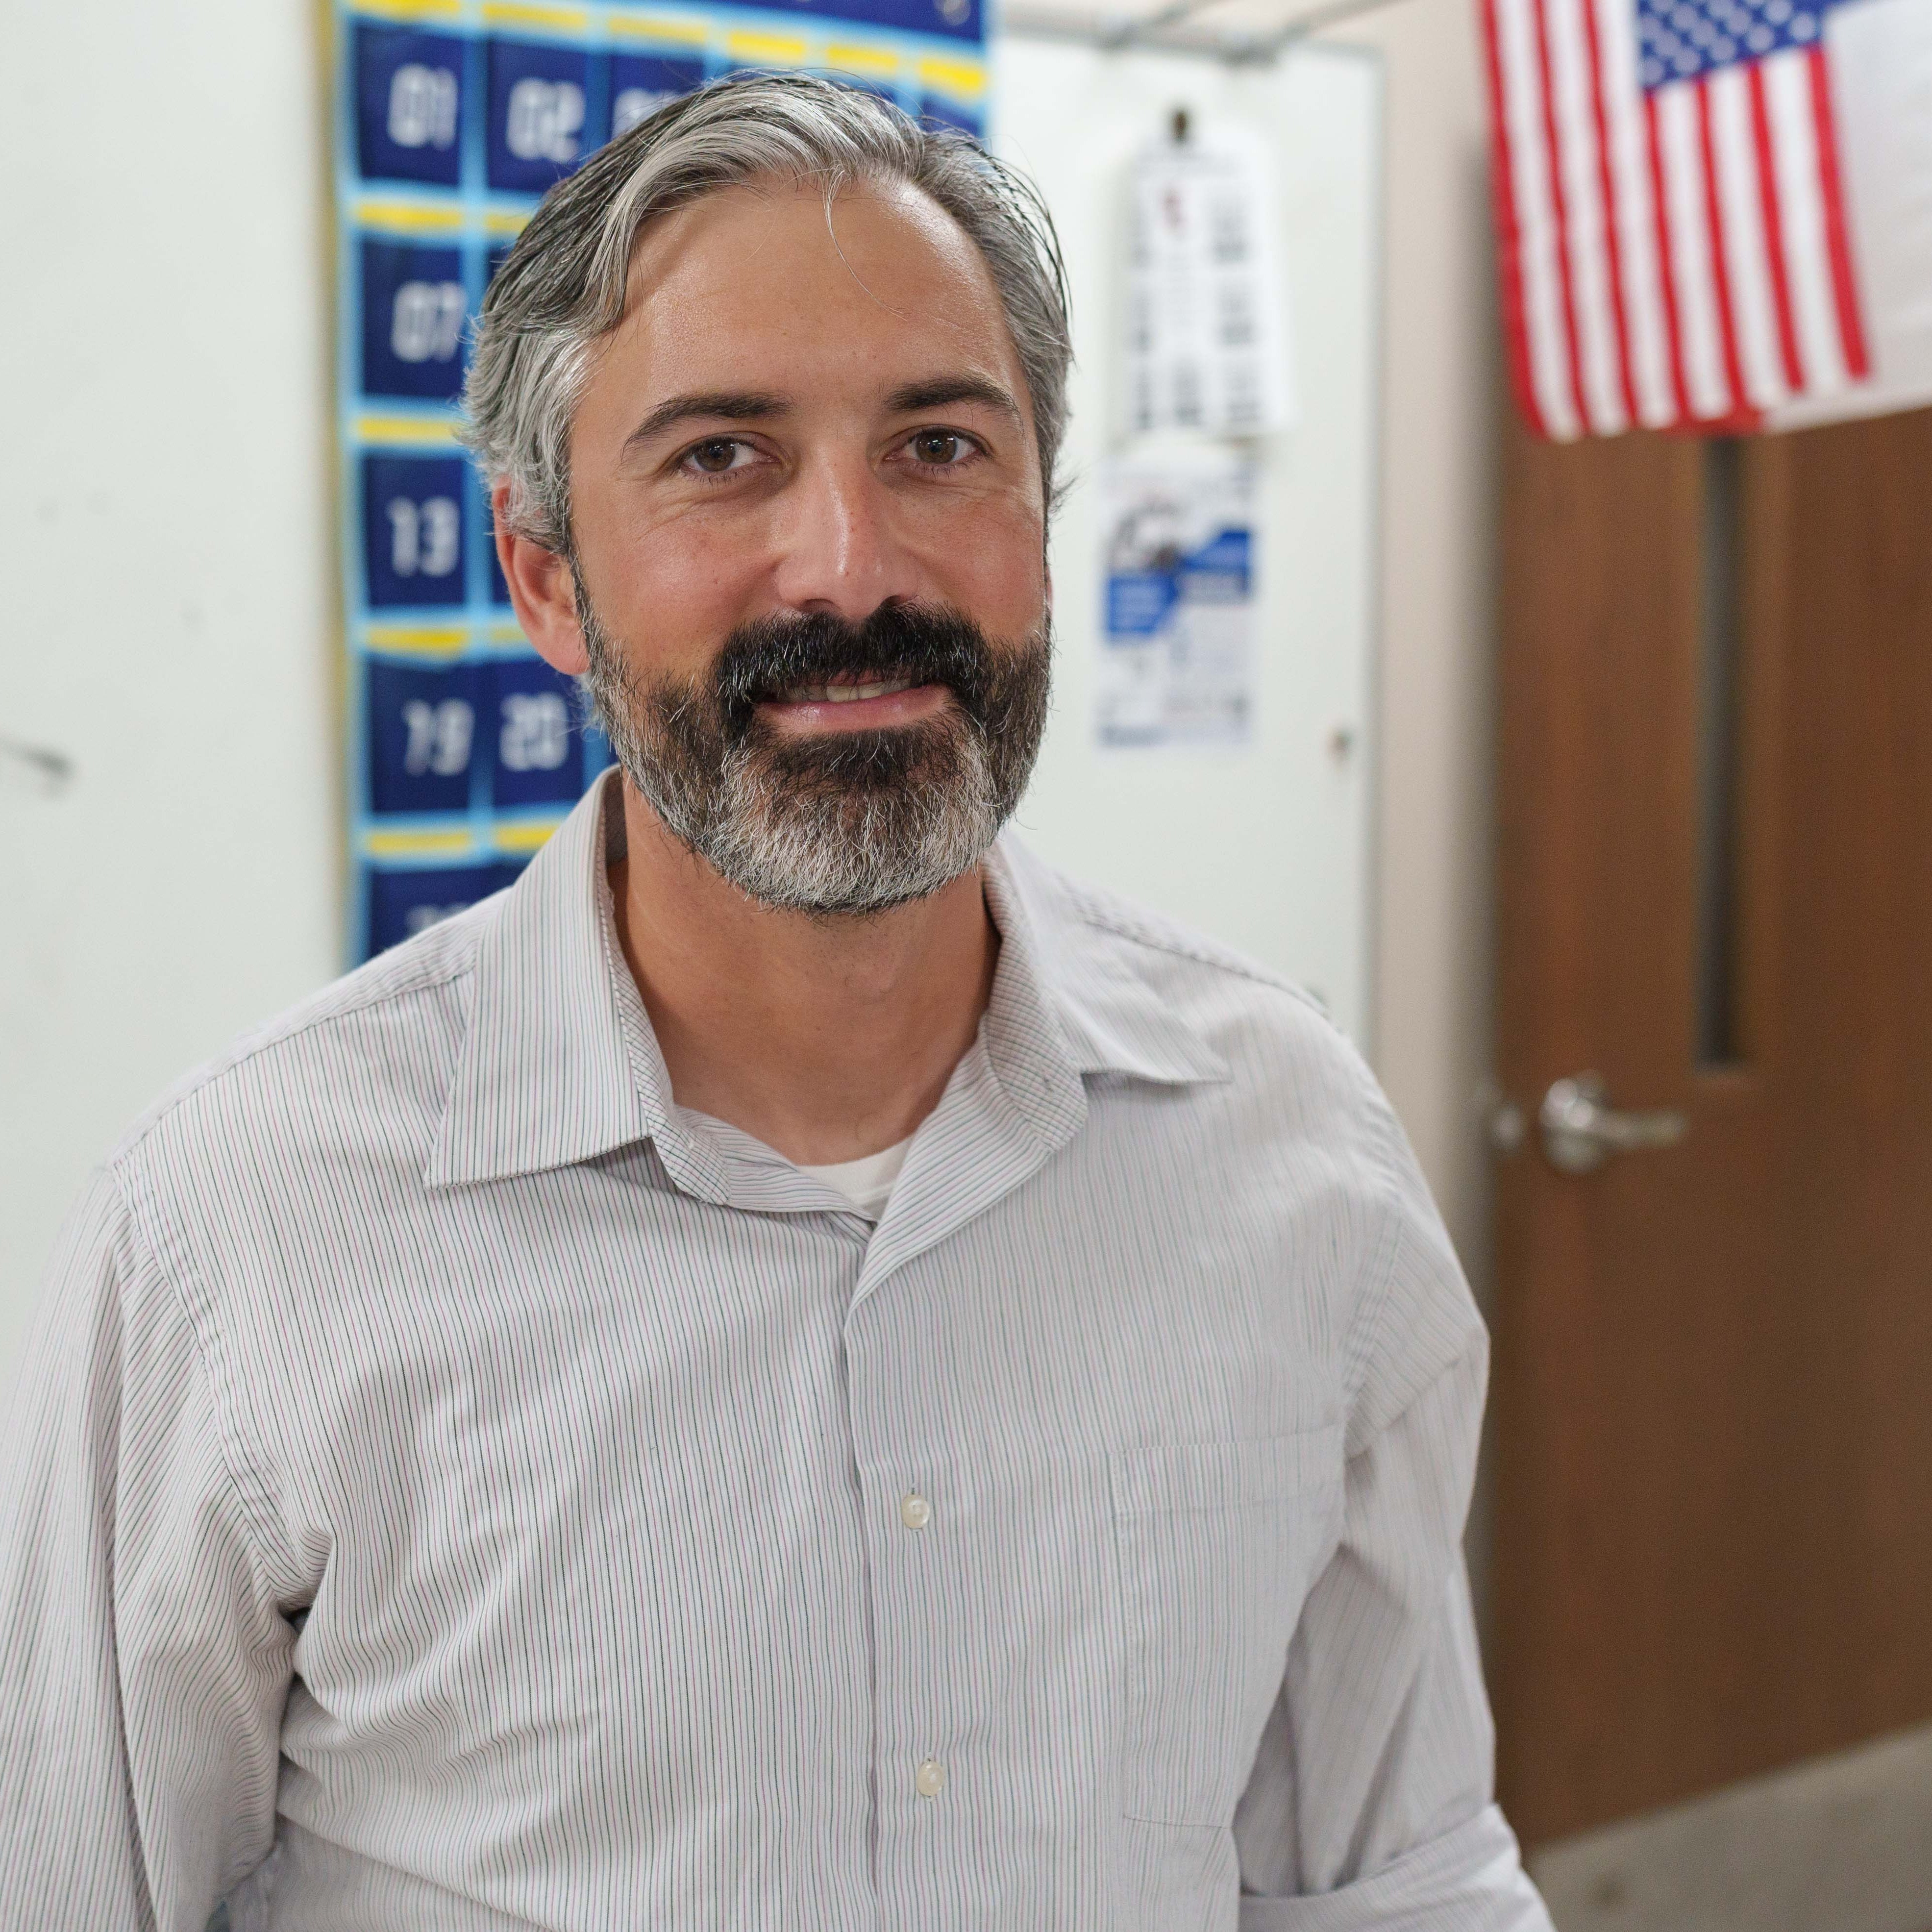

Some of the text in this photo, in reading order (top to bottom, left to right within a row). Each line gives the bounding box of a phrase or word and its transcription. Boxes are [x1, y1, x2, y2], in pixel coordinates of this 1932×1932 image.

[390, 64, 457, 149] 01
[508, 78, 584, 162] 02
[388, 497, 459, 576] 13
